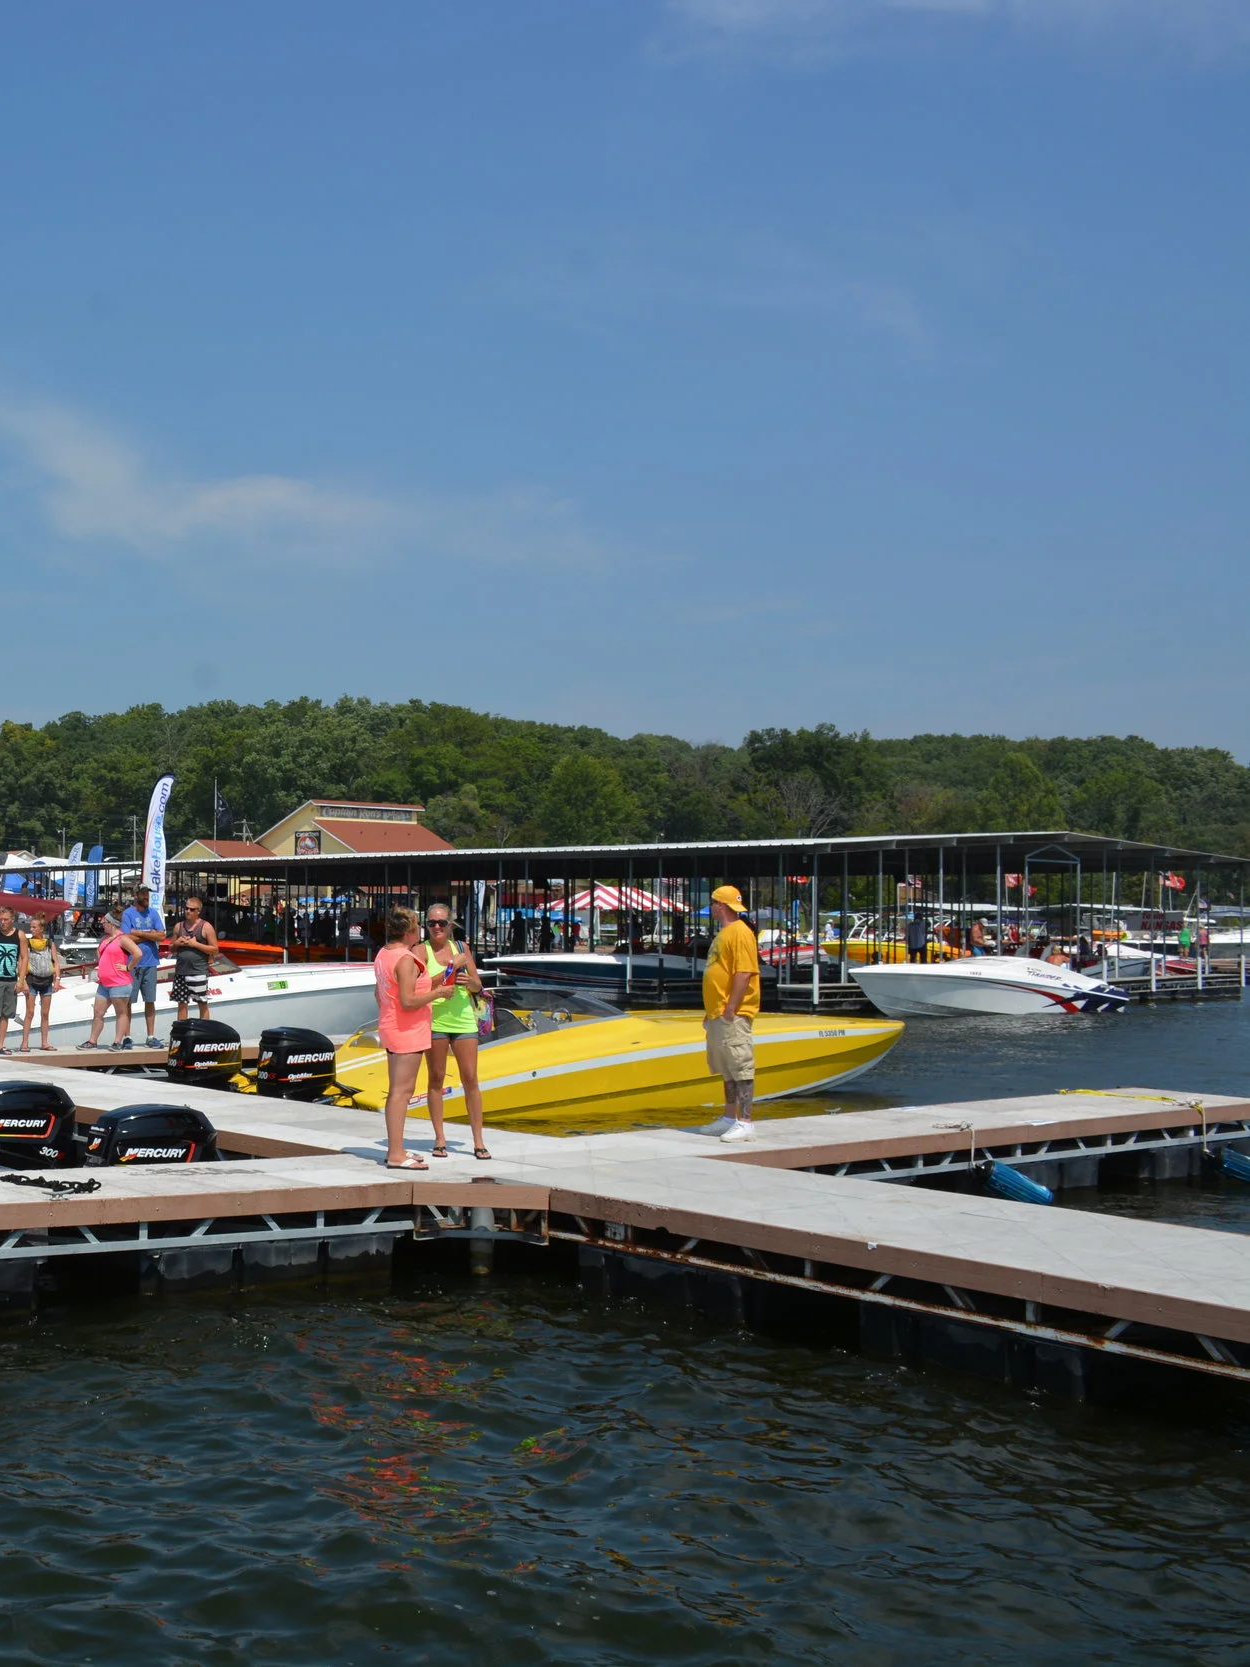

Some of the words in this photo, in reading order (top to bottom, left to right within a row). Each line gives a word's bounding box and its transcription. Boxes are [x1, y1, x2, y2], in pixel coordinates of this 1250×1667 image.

[193, 1041, 241, 1053] MERCURY
[287, 1052, 335, 1064] MERCURY
[124, 1148, 186, 1160] MERCURY
